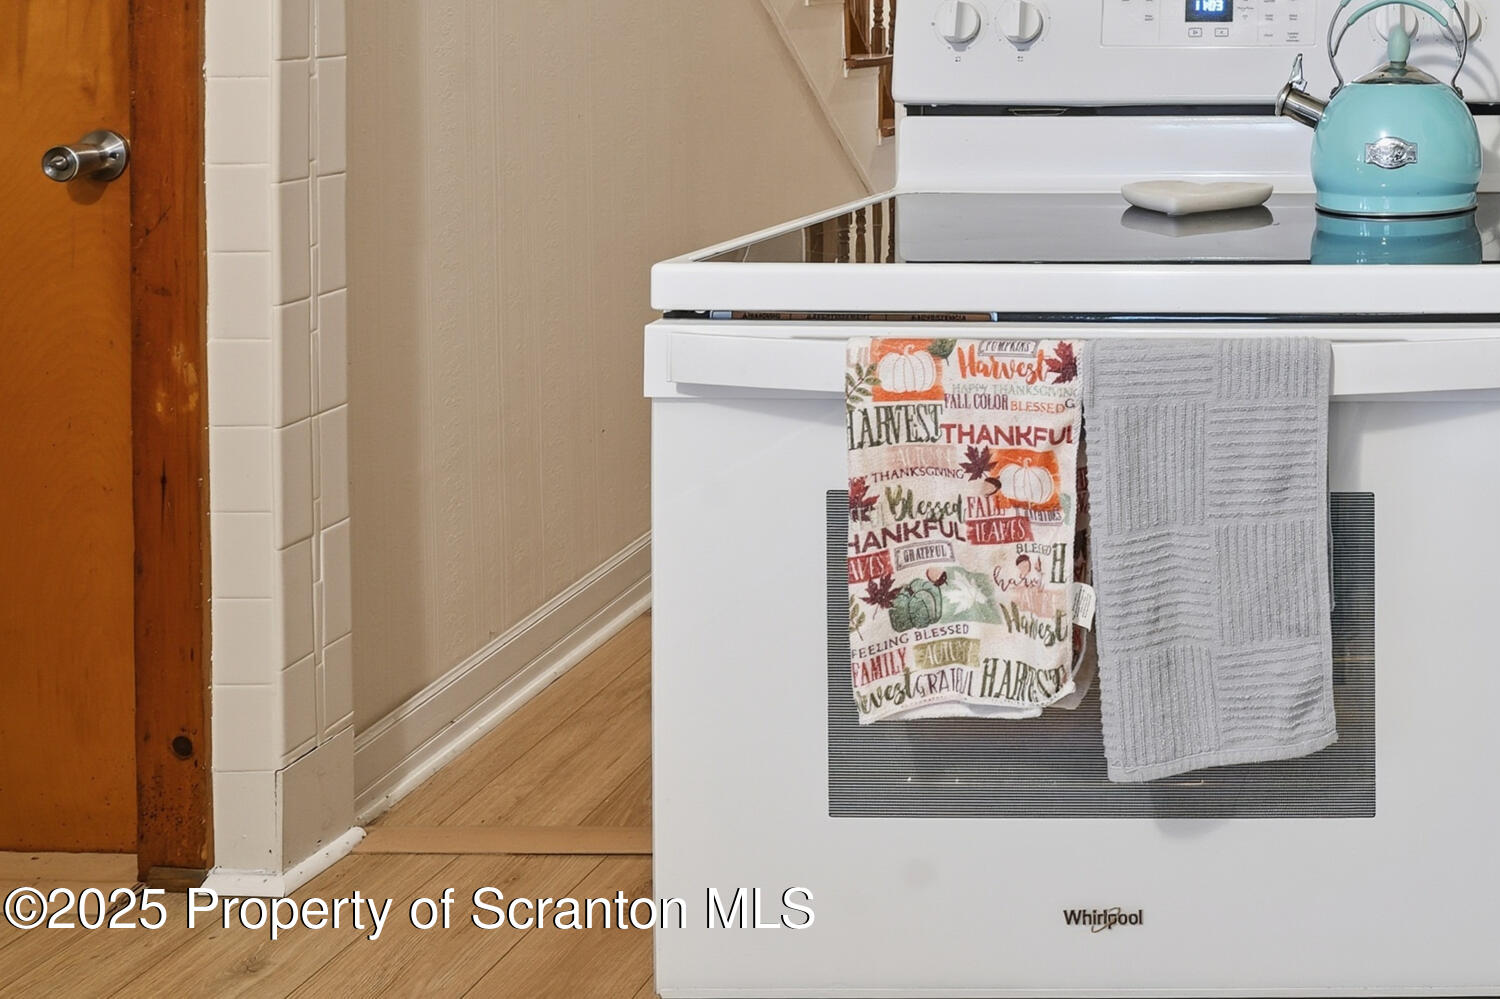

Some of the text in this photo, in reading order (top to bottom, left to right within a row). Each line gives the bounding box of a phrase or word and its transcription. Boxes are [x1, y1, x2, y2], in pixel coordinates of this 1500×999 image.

[957, 344, 1047, 385] Harvest
[944, 393, 1008, 410] FALL COLOR
[1010, 401, 1065, 414] BLESSED
[872, 466, 964, 483] THANKSGIVING
[975, 518, 1026, 543] LEAVES
[903, 545, 947, 562] GRATEFUL
[851, 623, 969, 659] FEELING BLESSED
[851, 647, 907, 688] FAMILY
[1063, 908, 1143, 930] Whirlpool
